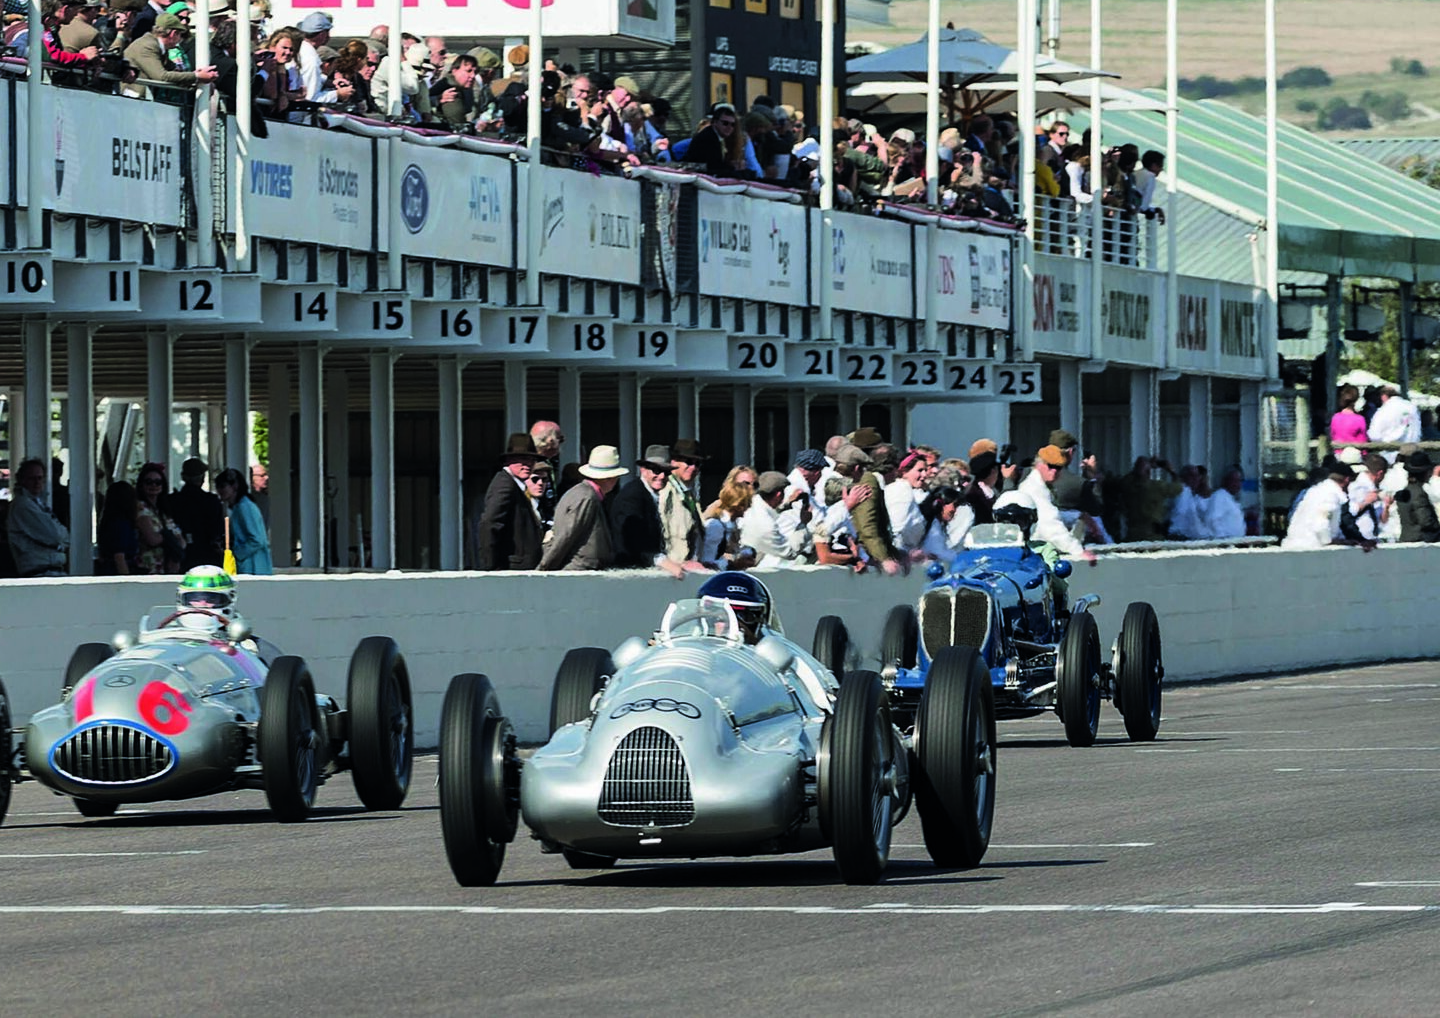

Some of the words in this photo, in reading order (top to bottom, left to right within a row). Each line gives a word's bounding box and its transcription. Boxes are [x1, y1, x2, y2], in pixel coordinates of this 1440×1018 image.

[112, 137, 172, 183] BELSTAFF
[6, 261, 44, 293] 10
[109, 270, 131, 301] 11
[179, 280, 214, 311] 12
[294, 292, 328, 322] 14
[372, 301, 404, 330] 15
[440, 309, 472, 337] 16
[507, 317, 539, 344] 17
[573, 323, 605, 352] 18
[637, 330, 668, 358] 19
[737, 342, 778, 370] 20
[804, 350, 833, 375] 21
[846, 354, 886, 380] 22
[901, 360, 938, 385] 23
[949, 365, 987, 390] 24
[998, 370, 1035, 395] 25
[75, 677, 193, 736] 16
